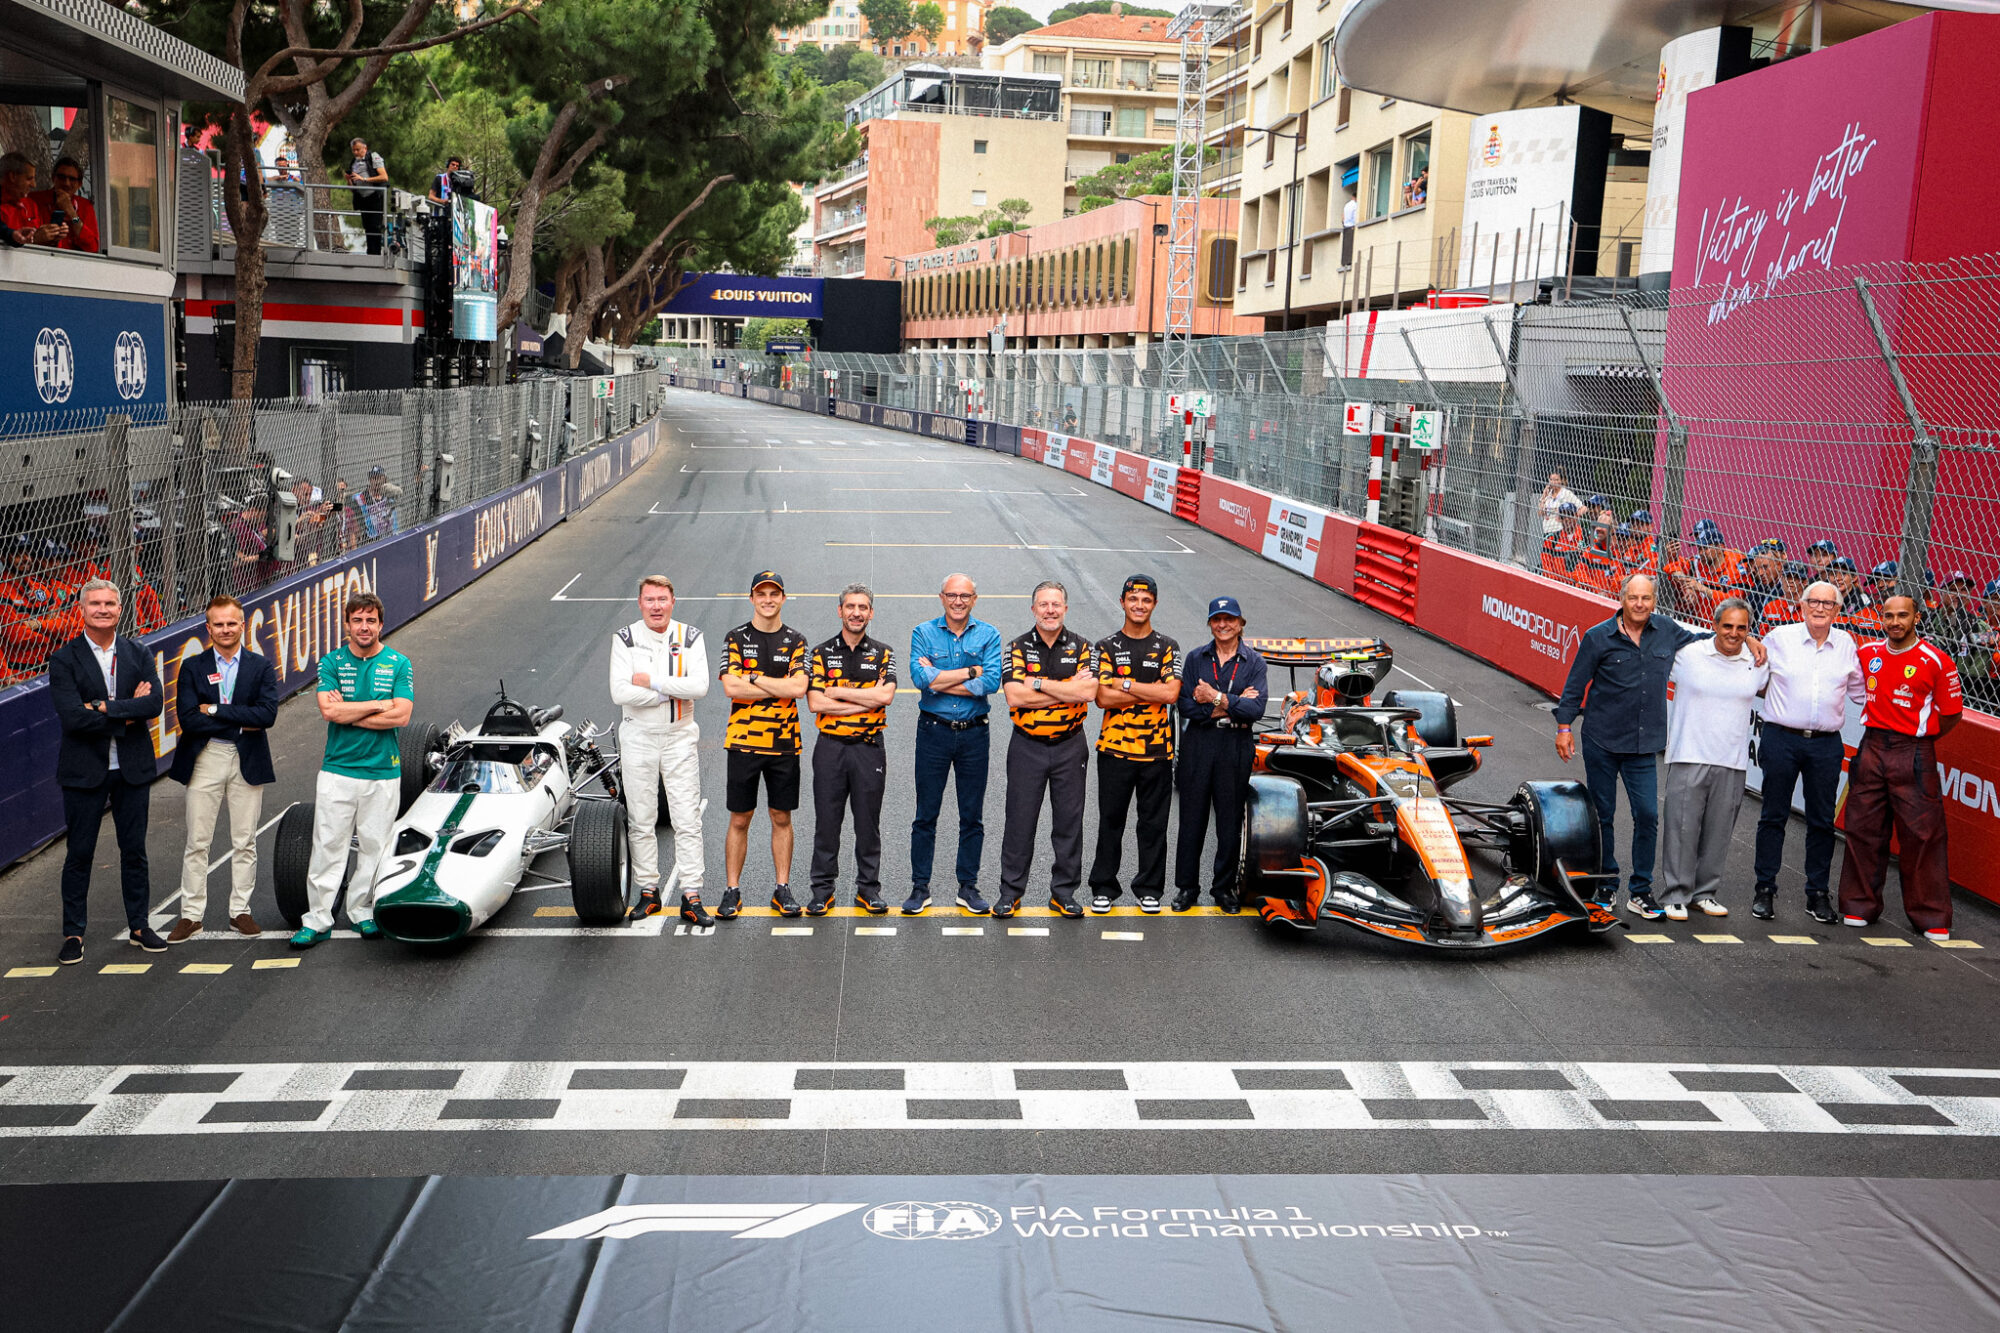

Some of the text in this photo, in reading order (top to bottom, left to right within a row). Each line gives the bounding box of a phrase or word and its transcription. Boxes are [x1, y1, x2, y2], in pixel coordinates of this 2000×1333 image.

[1510, 176, 1518, 184] IN
[1485, 185, 1517, 197] VUITTON
[1695, 122, 1876, 288] Victory is better
[1765, 195, 1847, 299] shared
[716, 289, 813, 304] LOUIS VUITTON
[931, 416, 967, 440] LOUIS VUITTON
[1412, 432, 1433, 440] EXIT
[473, 483, 543, 569] LOUIS VUITTON
[1530, 639, 1560, 660] SINCE 1929
[391, 755, 400, 767] 14
[1010, 1206, 1313, 1221] FIA Formula 1
[1012, 1223, 1147, 1238] World
